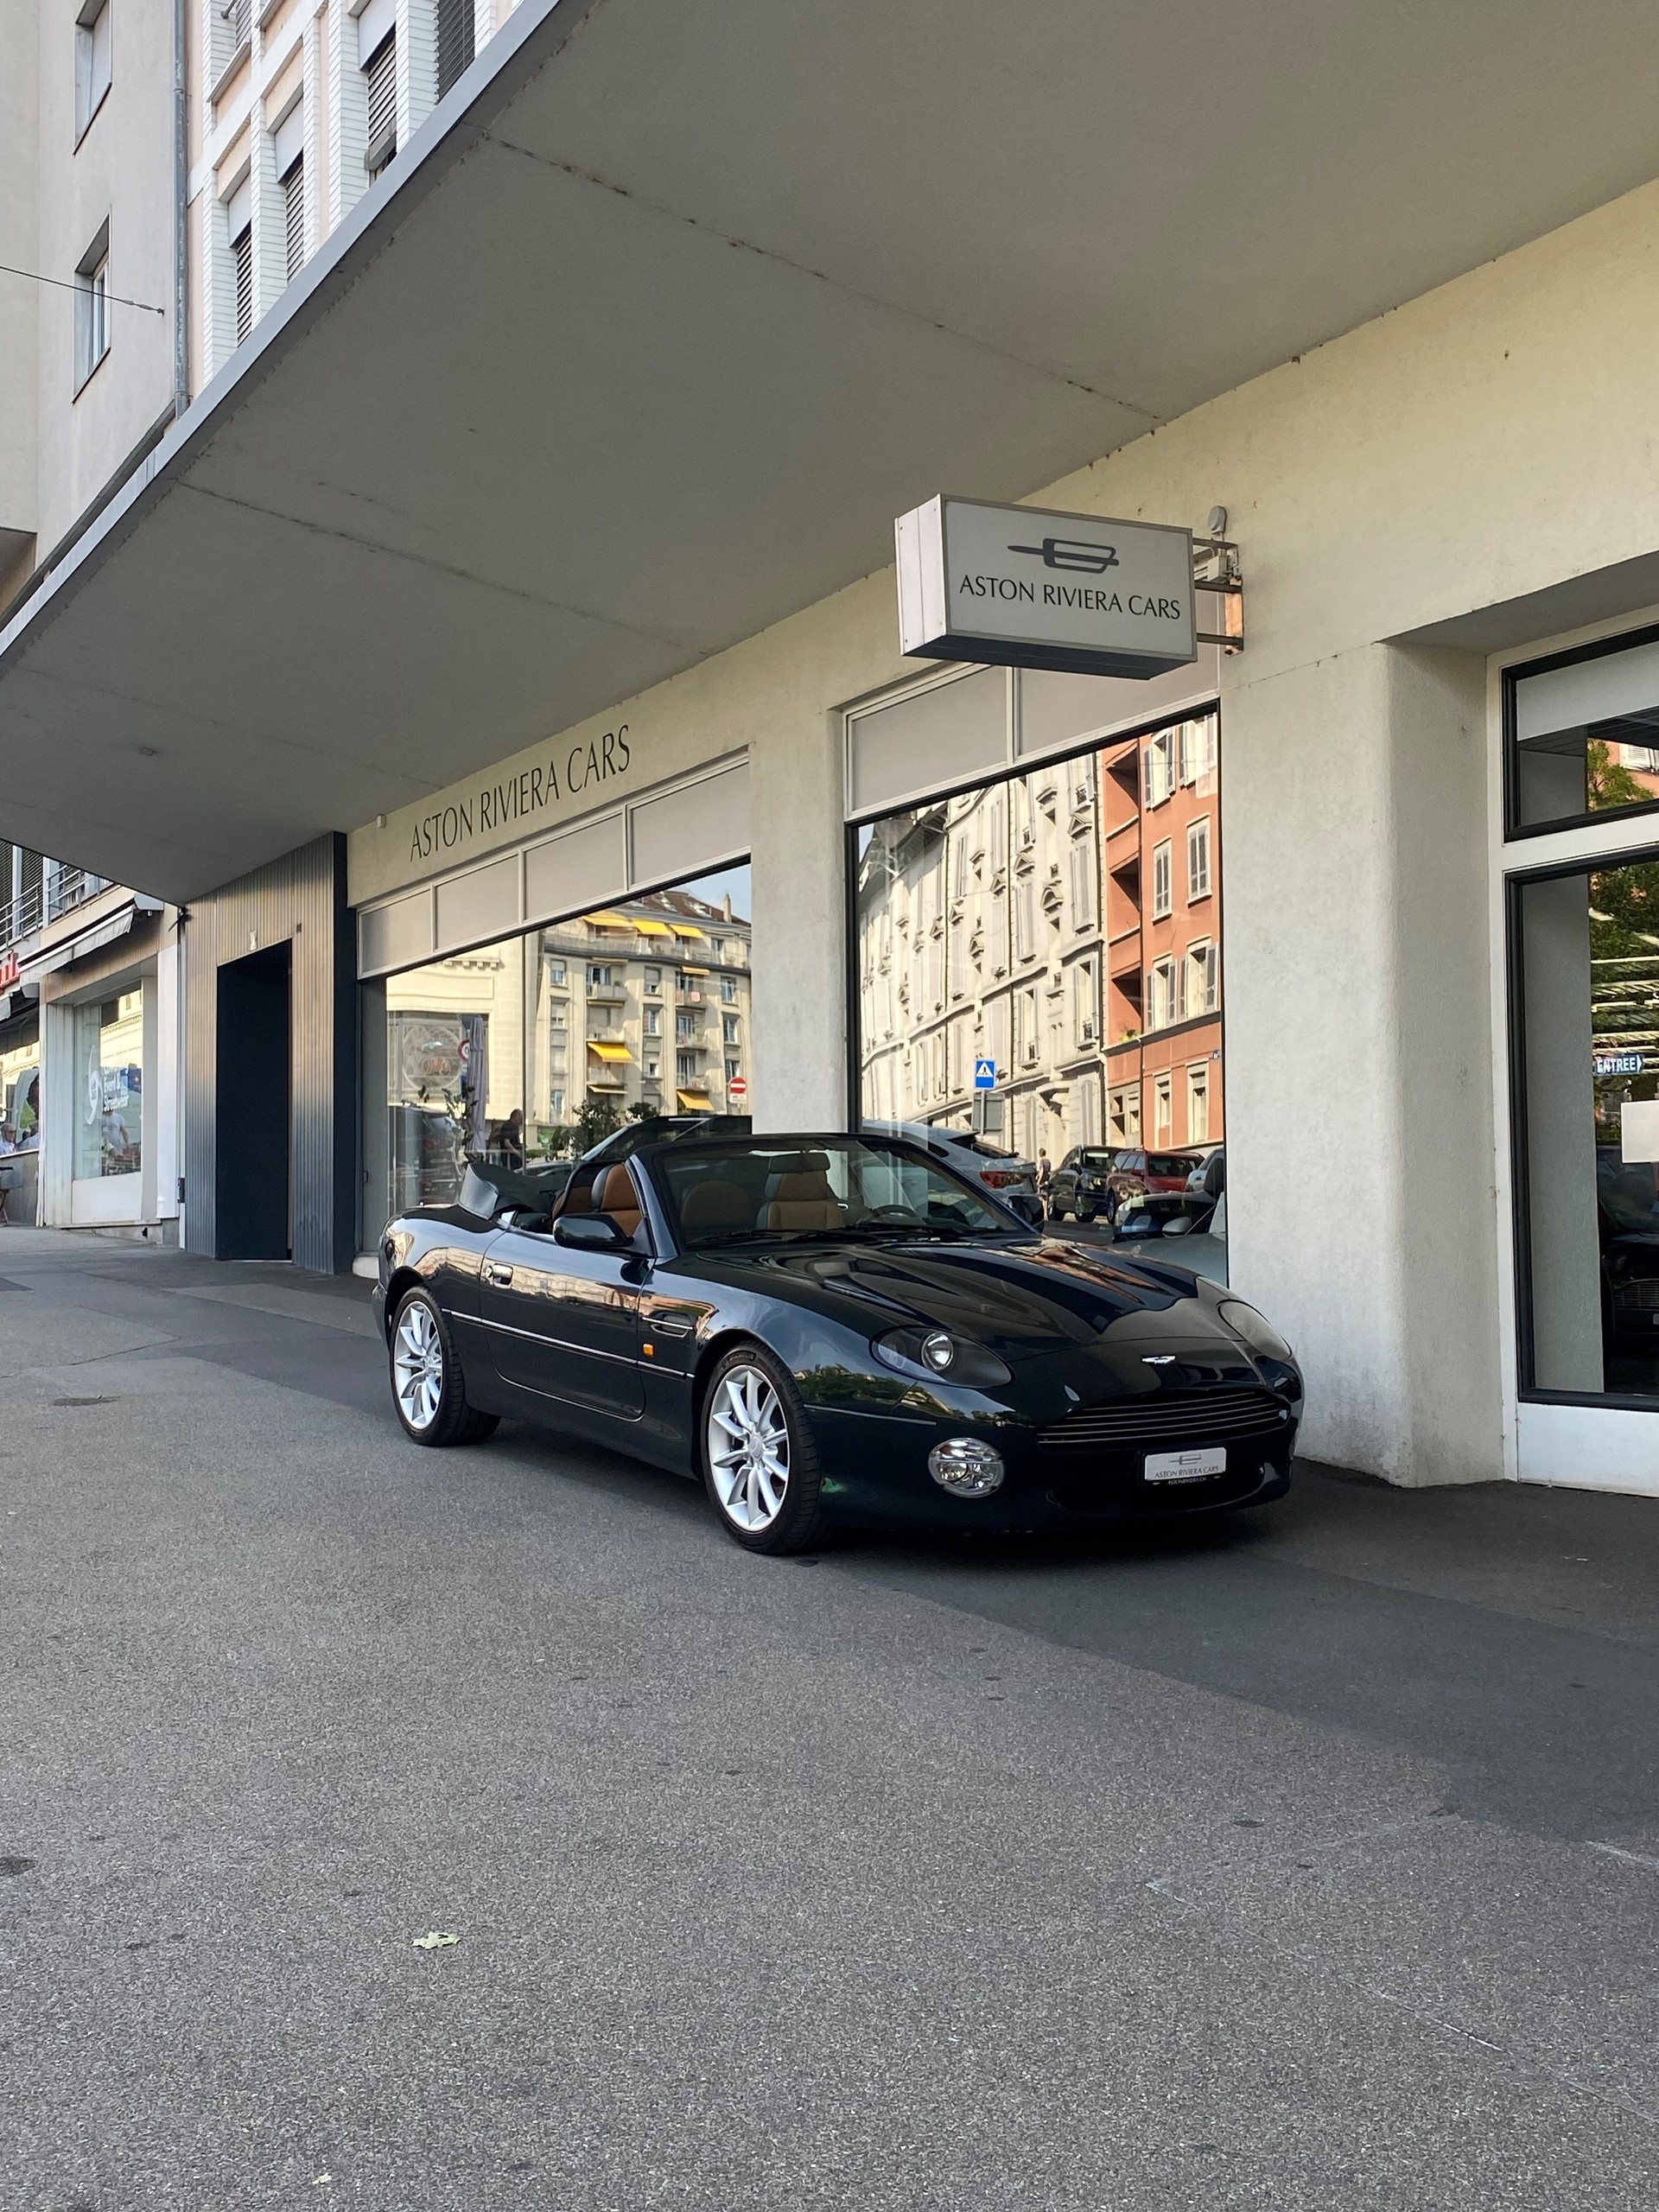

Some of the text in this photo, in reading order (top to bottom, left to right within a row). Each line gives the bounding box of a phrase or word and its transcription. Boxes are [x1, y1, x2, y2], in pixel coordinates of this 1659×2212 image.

[959, 574, 1180, 620] ASTON RIVIERA CARS
[410, 724, 631, 863] ASTON RIVIERA CARS
[1597, 1058, 1636, 1073] ENTREE
